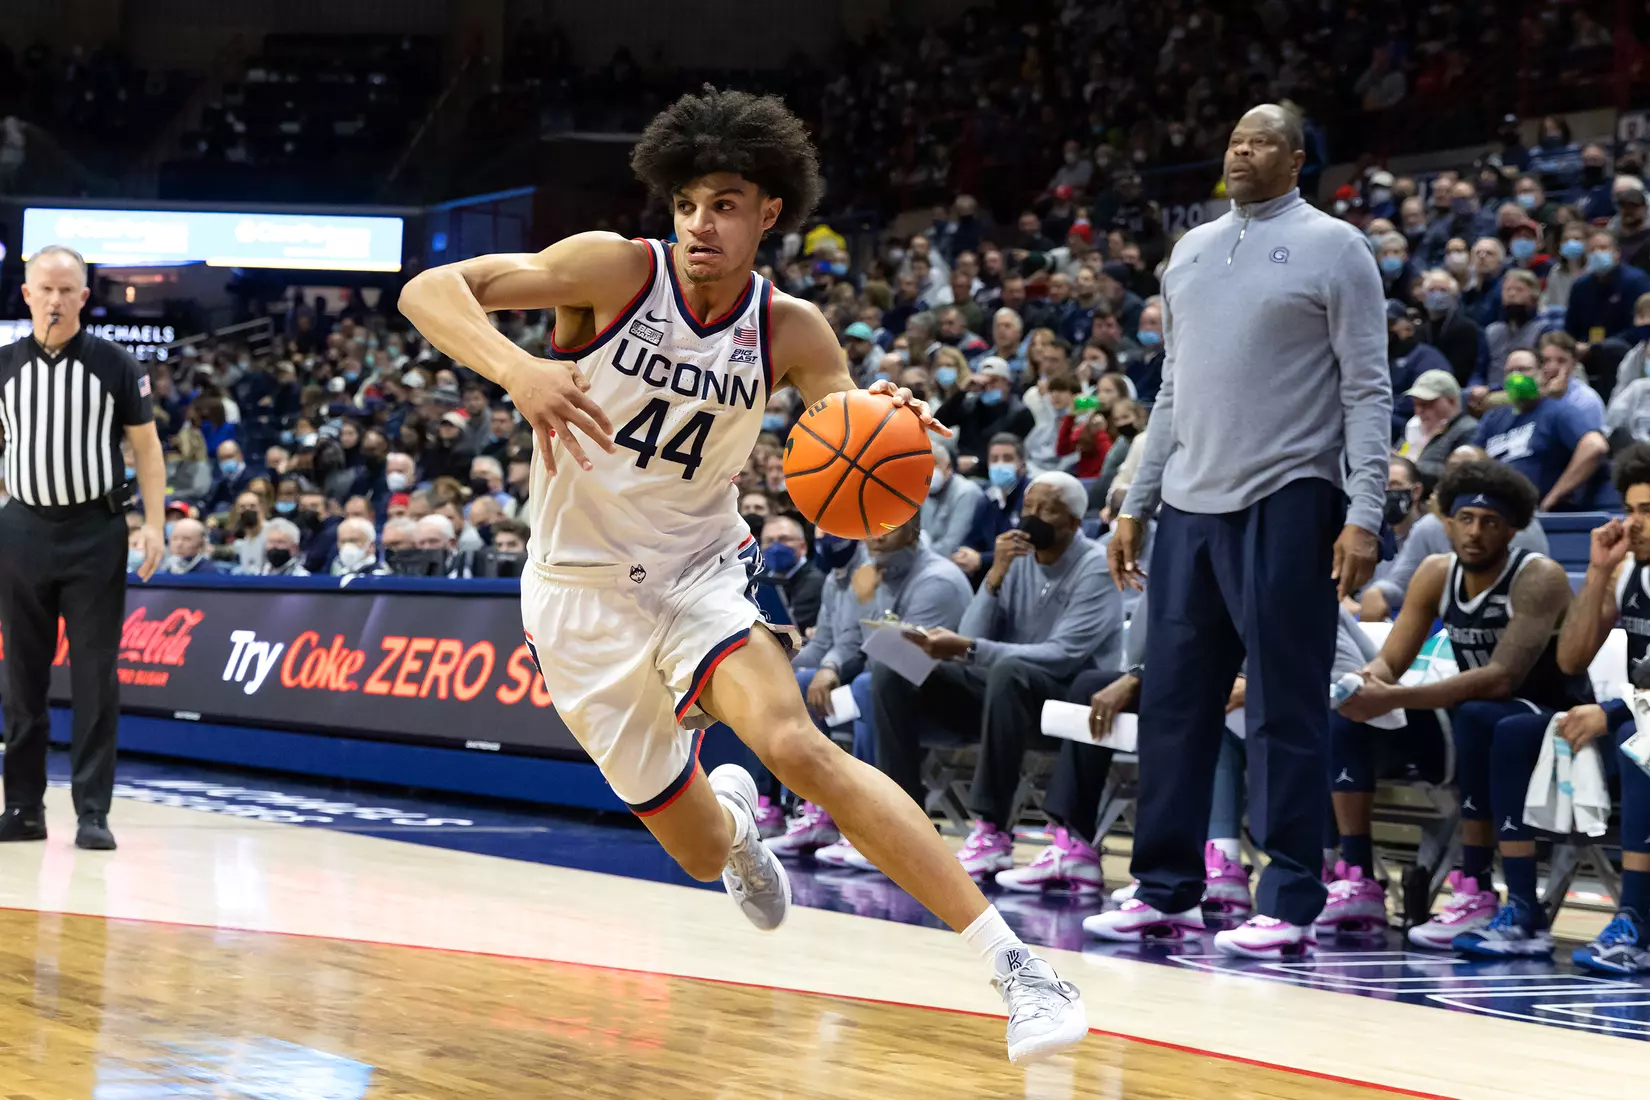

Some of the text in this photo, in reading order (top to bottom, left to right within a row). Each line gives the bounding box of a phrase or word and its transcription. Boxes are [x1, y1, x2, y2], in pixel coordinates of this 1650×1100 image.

[611, 338, 759, 410] UCONN
[730, 354, 758, 362] EAST
[733, 348, 754, 356] BIG
[614, 397, 717, 481] 44
[222, 630, 285, 695] Try
[280, 630, 366, 692] Coke
[363, 635, 496, 701] ZERO
